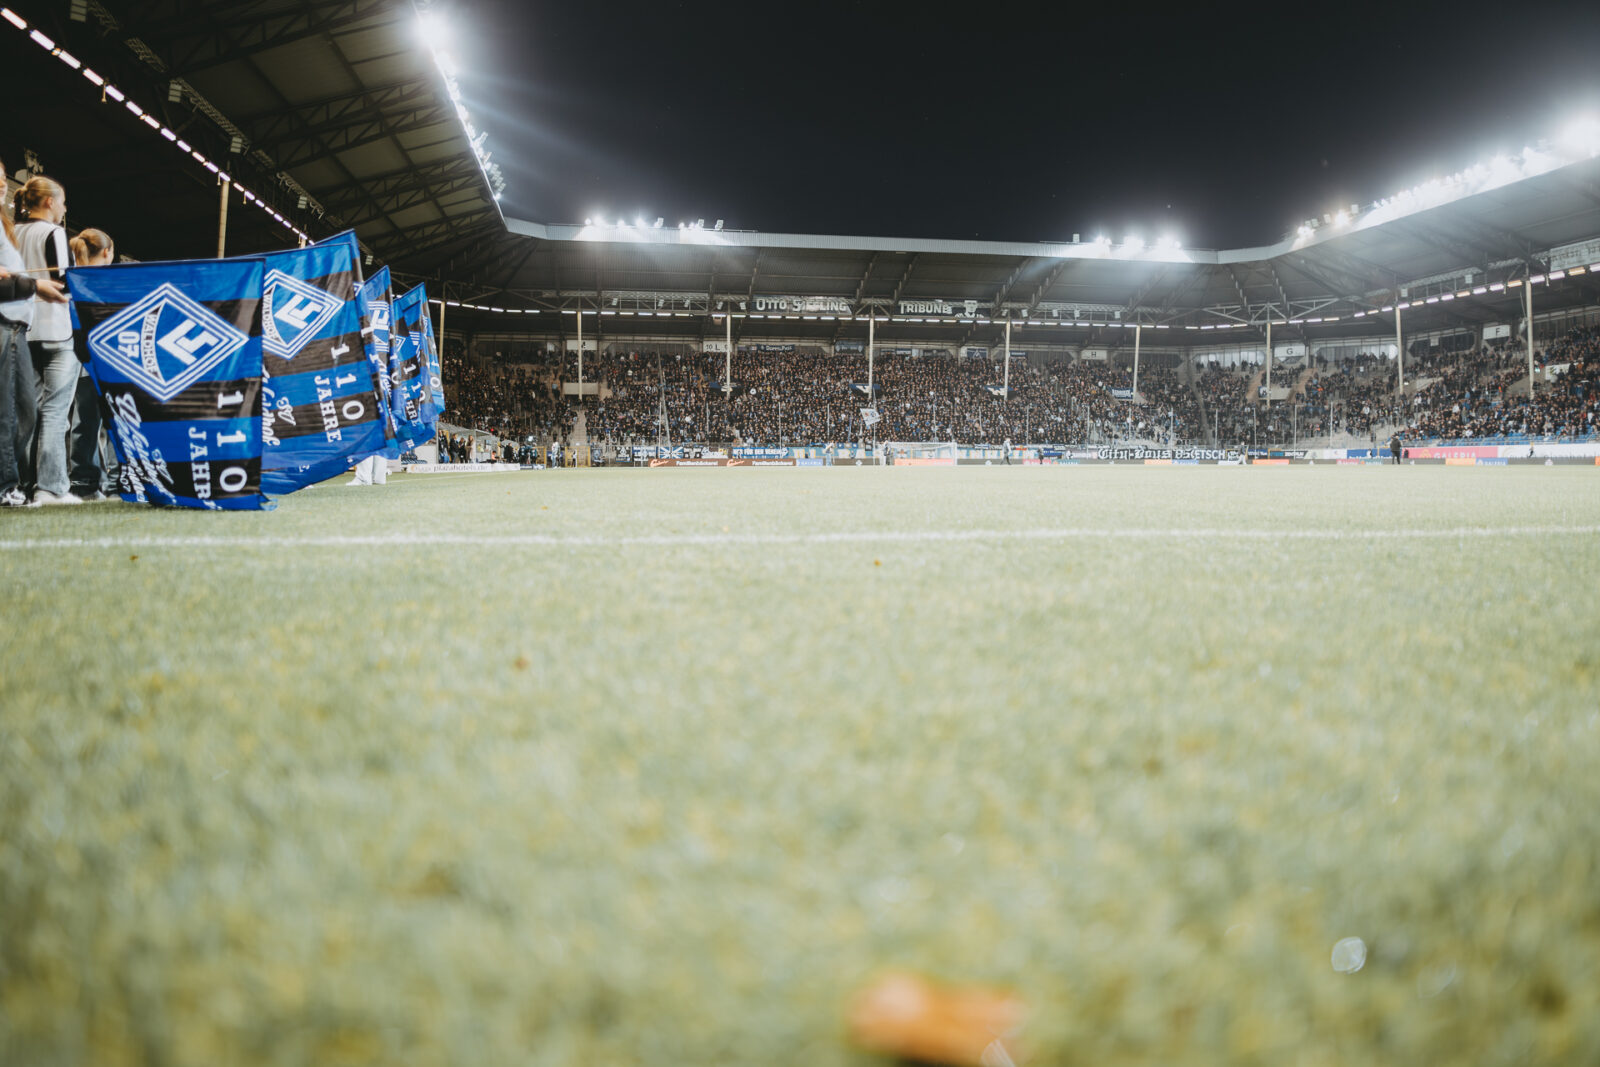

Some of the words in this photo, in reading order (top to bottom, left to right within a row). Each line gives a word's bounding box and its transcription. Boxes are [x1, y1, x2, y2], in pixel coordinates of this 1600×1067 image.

[756, 298, 788, 311] OTTO
[1495, 327, 1502, 336] F
[116, 331, 141, 359] 07
[142, 313, 159, 374] WALDHOF
[1286, 347, 1294, 355] G
[313, 375, 343, 444] JAHRE
[1189, 449, 1226, 460] ETSCH
